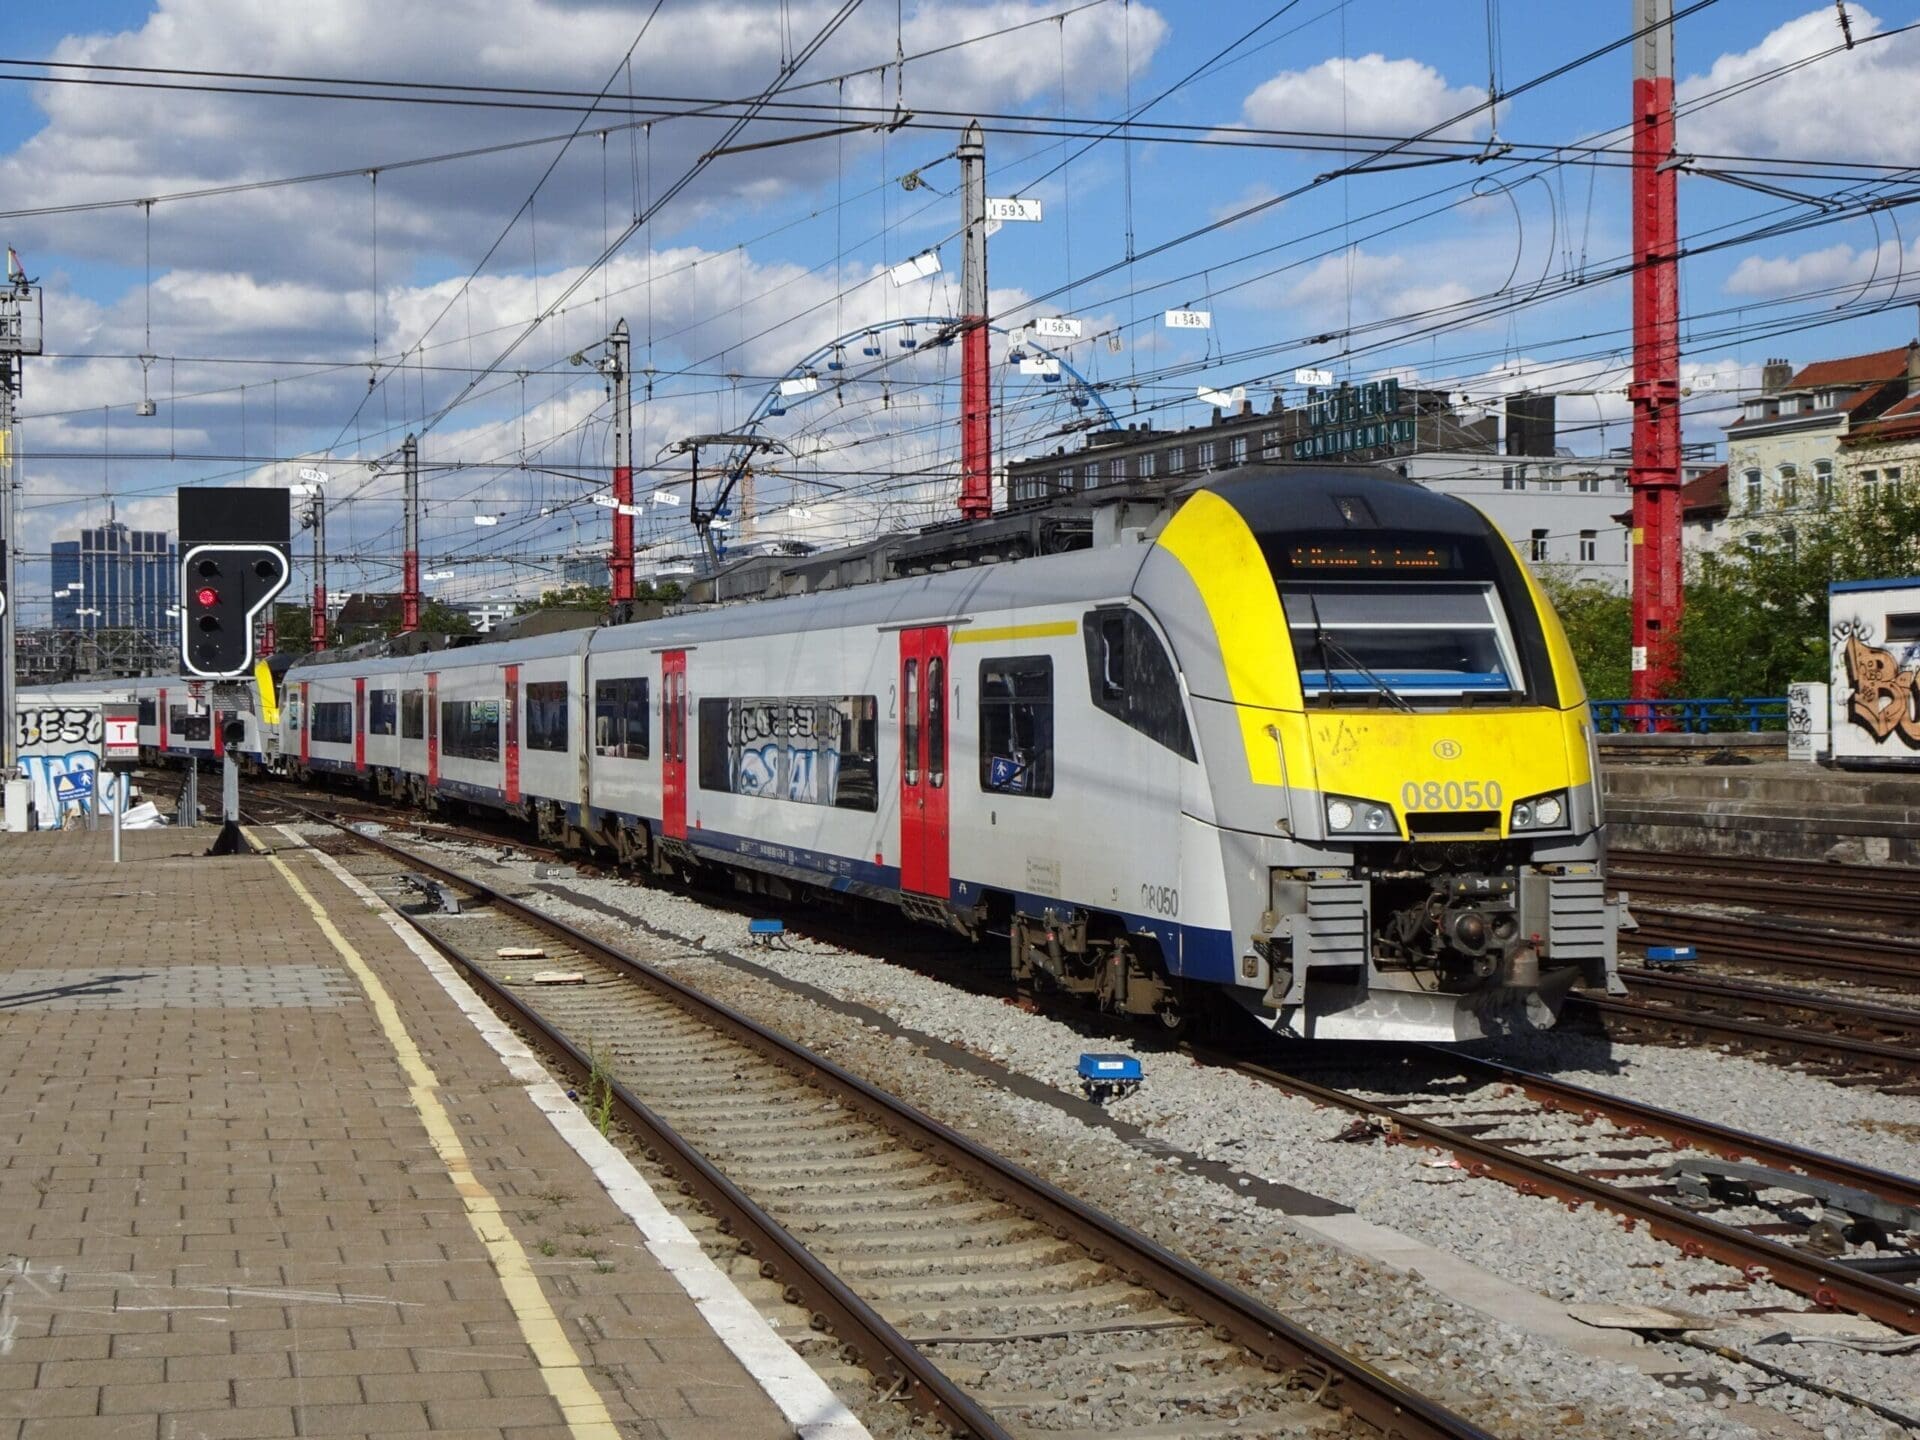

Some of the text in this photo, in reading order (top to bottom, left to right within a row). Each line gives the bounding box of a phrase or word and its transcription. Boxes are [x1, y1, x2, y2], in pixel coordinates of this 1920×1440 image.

[1000, 204, 1026, 217] 593
[1293, 420, 1411, 457] CONTINENTAL
[889, 683, 897, 719] 2
[954, 684, 960, 720] 1
[115, 723, 128, 741] T
[1401, 780, 1503, 811] 08050
